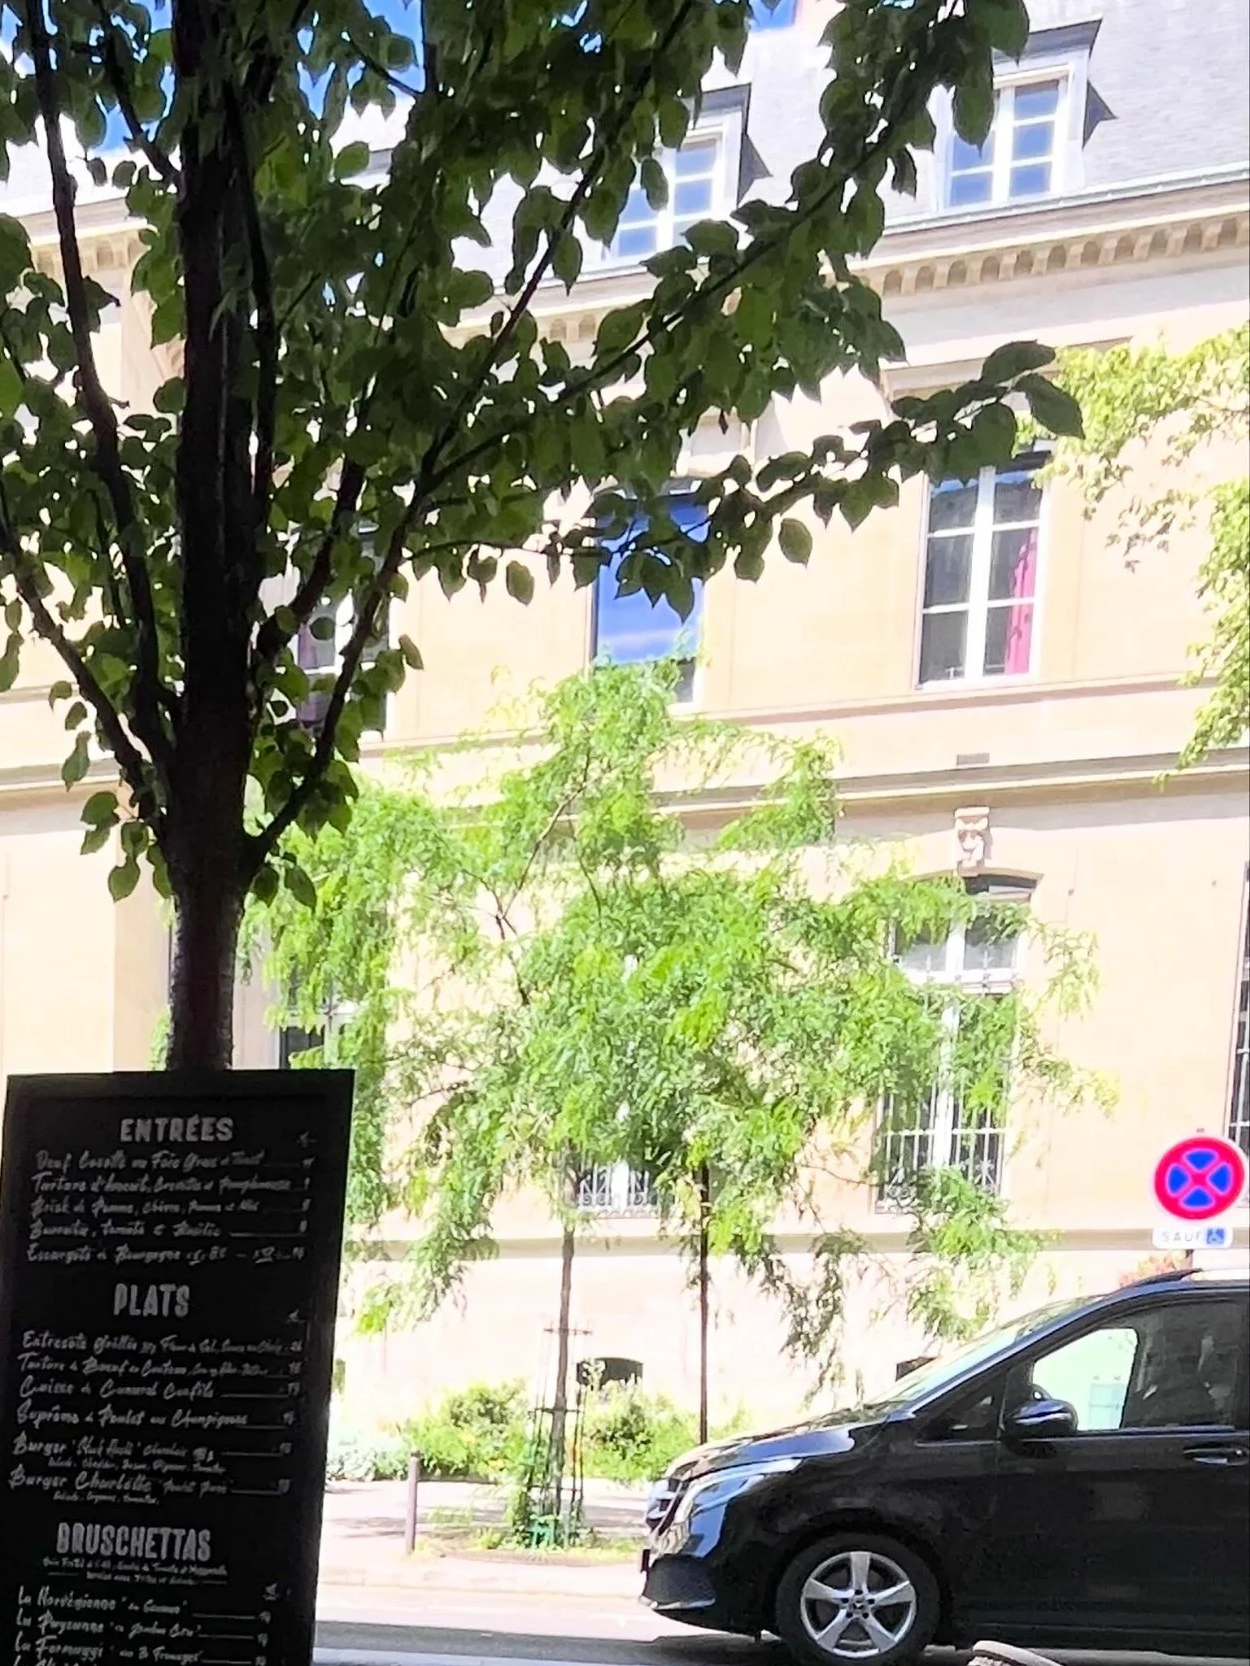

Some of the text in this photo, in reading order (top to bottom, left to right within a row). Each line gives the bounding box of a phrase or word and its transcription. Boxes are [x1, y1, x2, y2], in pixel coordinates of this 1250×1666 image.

[120, 1114, 234, 1142] ENTRÉES
[113, 1283, 190, 1317] PLATS
[12, 1430, 67, 1456] Burger
[9, 1464, 68, 1490] Burger
[56, 1522, 211, 1561] BRUSCHETTAS
[18, 1586, 32, 1606] La
[16, 1608, 32, 1626] La
[15, 1631, 31, 1652] La
